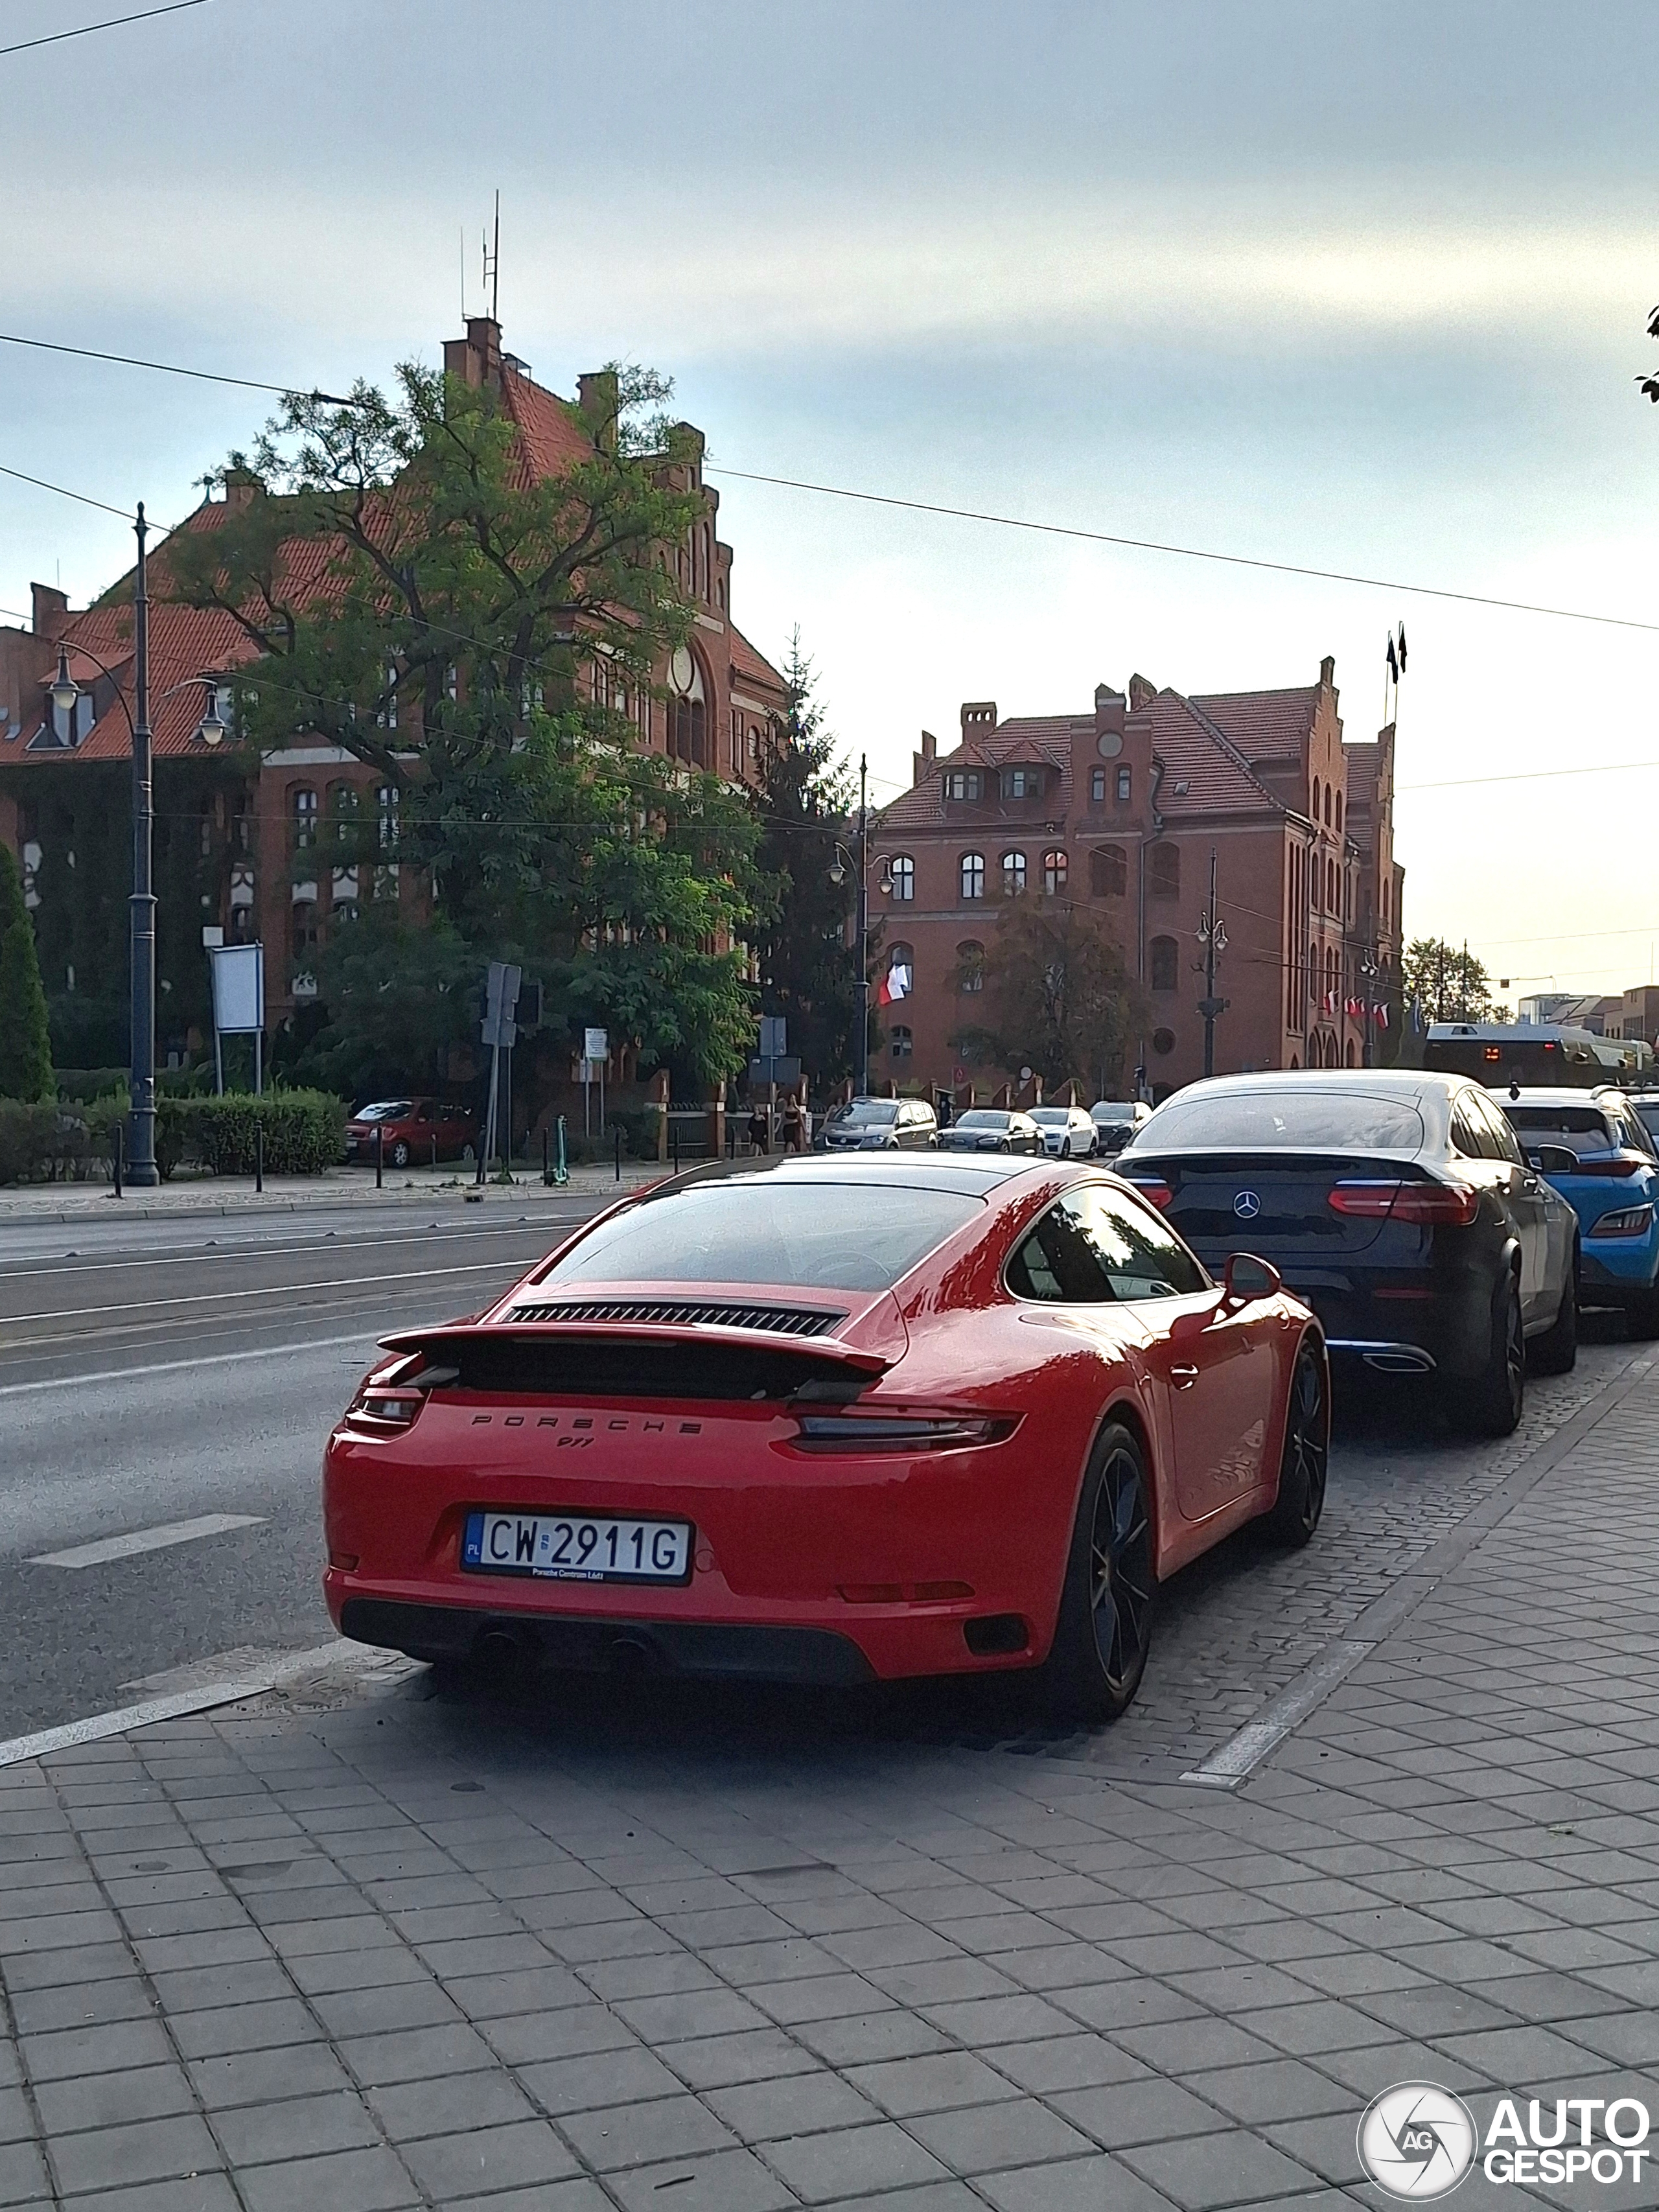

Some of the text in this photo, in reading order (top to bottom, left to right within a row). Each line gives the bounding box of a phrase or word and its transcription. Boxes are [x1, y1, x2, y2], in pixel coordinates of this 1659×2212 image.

[472, 1415, 702, 1434] PORSCHE
[557, 1437, 594, 1448] 911
[467, 1544, 480, 1555] PL
[490, 1520, 678, 1570] CW 2911G
